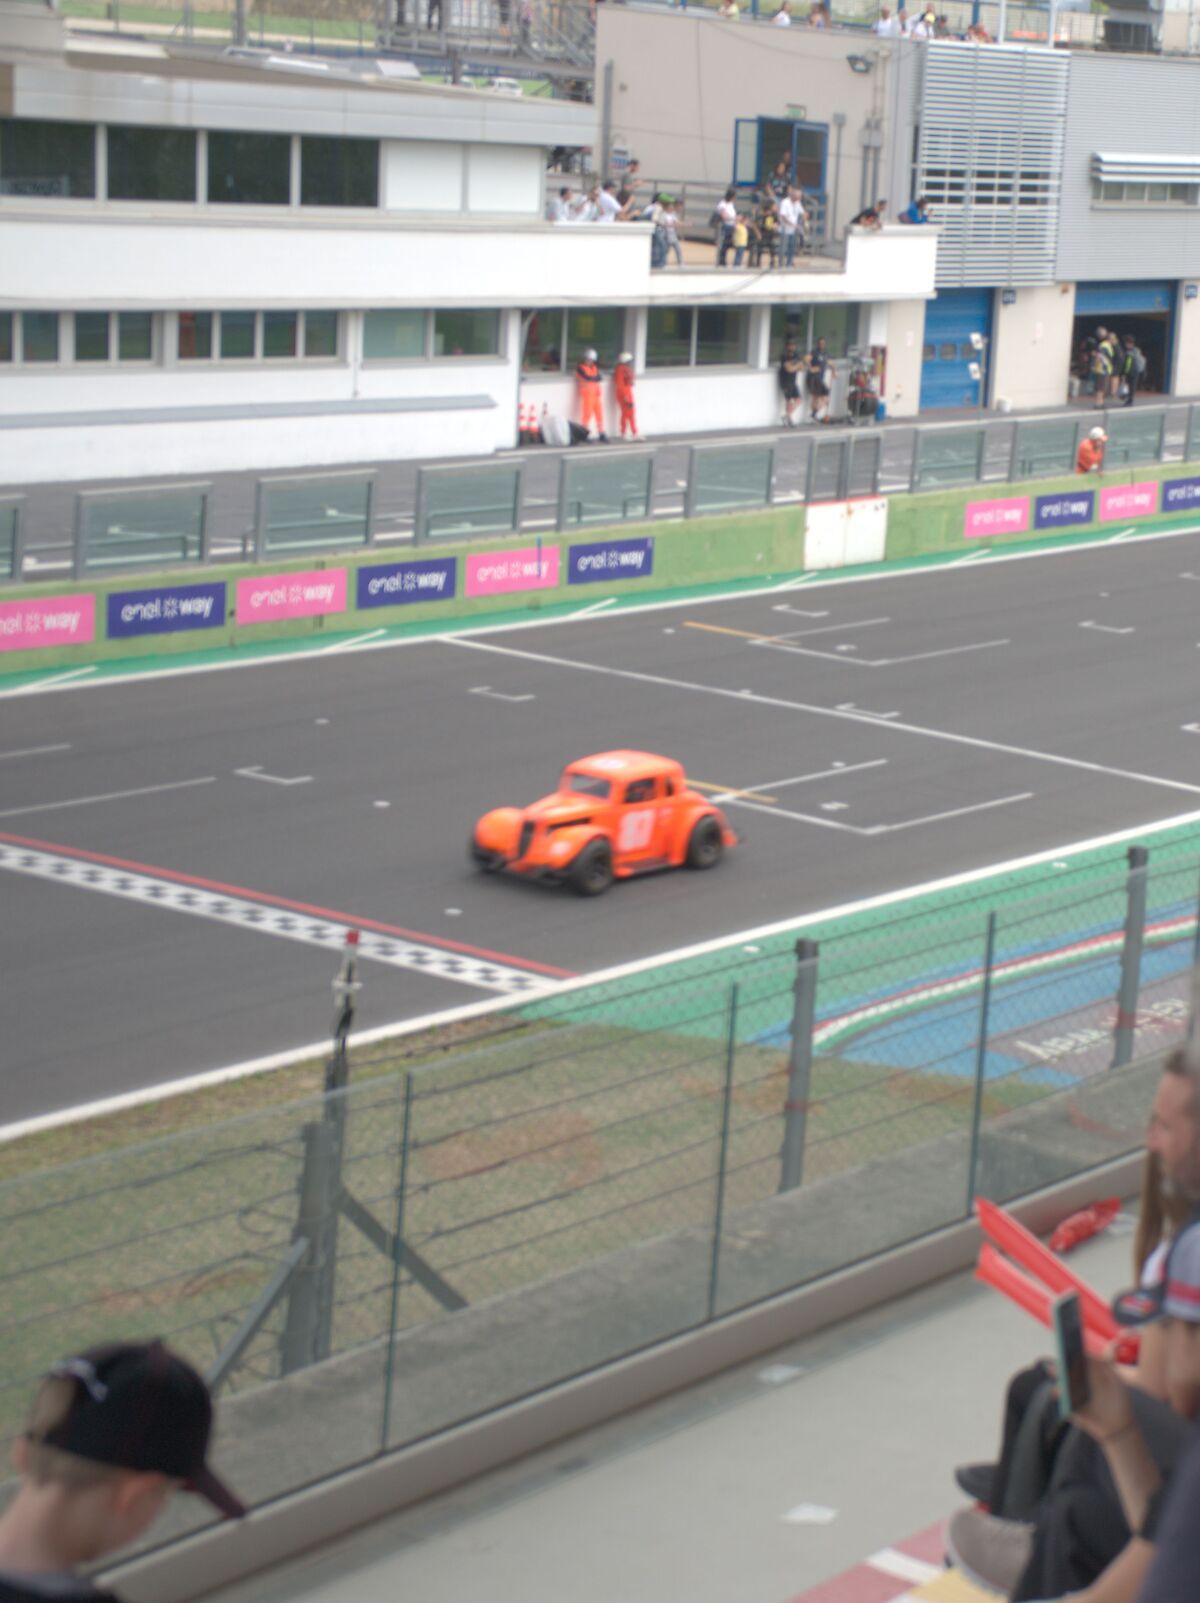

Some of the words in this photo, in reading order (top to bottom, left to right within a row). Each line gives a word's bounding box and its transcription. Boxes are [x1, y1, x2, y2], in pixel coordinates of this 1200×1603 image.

[1167, 487, 1186, 501] enel
[1003, 508, 1022, 524] way
[1041, 503, 1062, 519] enel
[1070, 501, 1088, 517] way
[476, 559, 508, 582] enel
[577, 550, 606, 572] enel
[620, 549, 645, 570] way
[250, 583, 287, 607] enel
[303, 582, 336, 605] way
[368, 572, 402, 595] enel
[418, 571, 447, 592] way
[120, 597, 161, 623] enel
[179, 595, 215, 618] way
[44, 611, 81, 633] way
